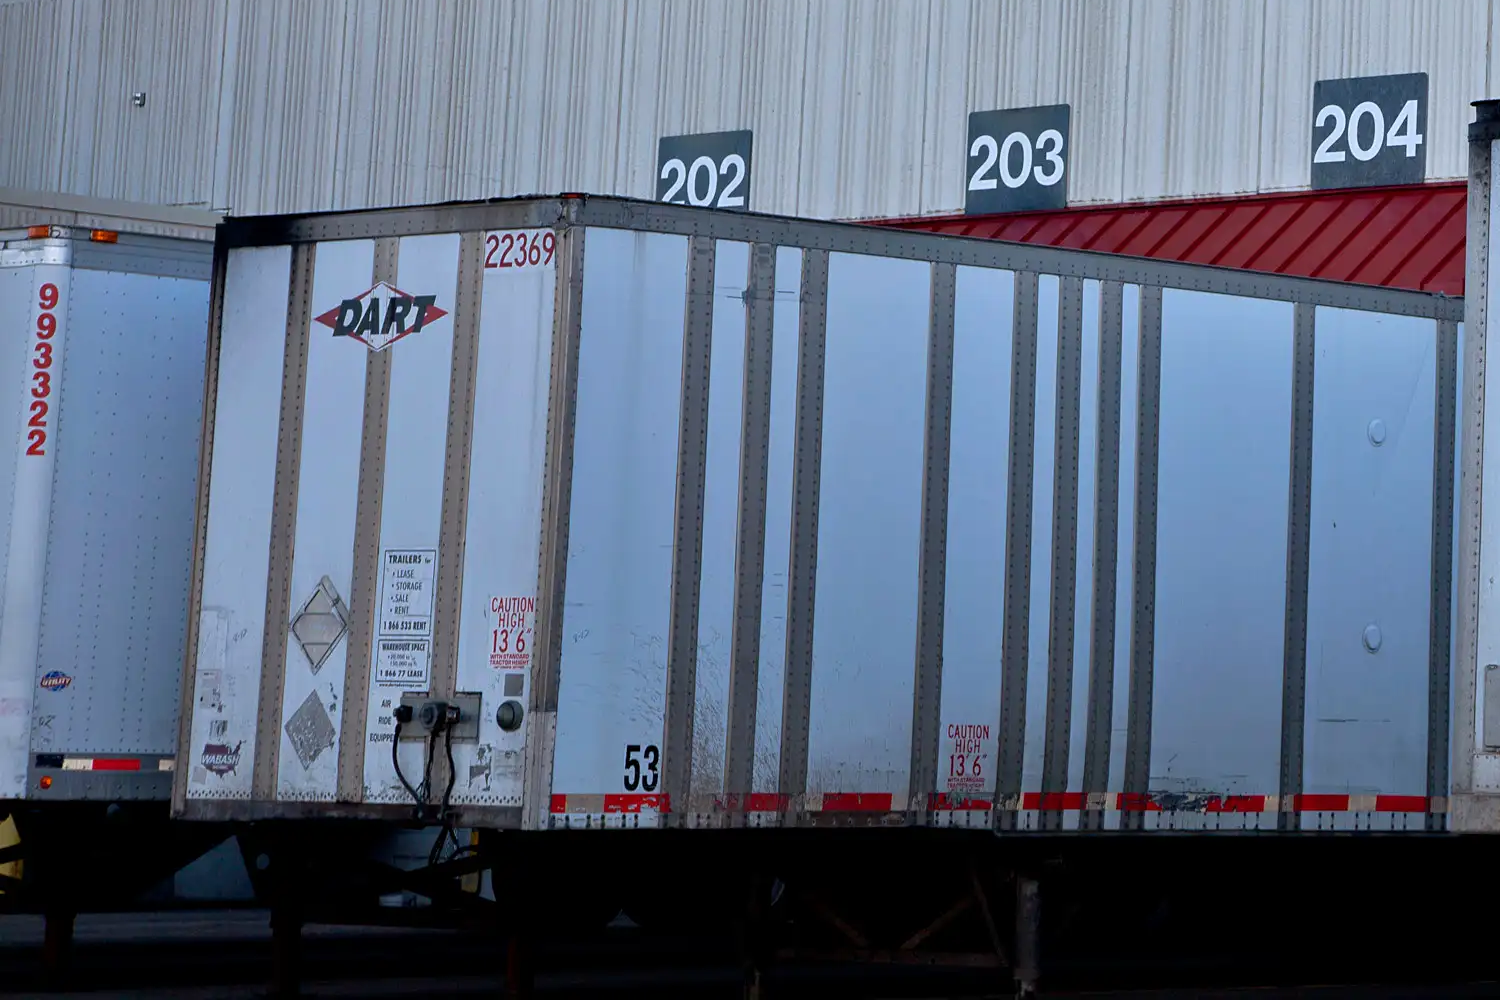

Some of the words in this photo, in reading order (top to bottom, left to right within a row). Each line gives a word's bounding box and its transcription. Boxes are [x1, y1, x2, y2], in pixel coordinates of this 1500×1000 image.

[1313, 100, 1423, 163] 204
[968, 129, 1065, 191] 203
[660, 154, 746, 208] 202
[485, 232, 556, 268] 22369
[333, 295, 437, 337] DART
[26, 283, 59, 456] 993322
[389, 555, 422, 564] TRAILERS
[397, 570, 414, 578] LEASE
[396, 582, 422, 590] STORAGE
[395, 594, 408, 602] SALE
[394, 606, 409, 614] RENT
[492, 597, 534, 612] CAUTION
[388, 621, 399, 630] 866
[400, 622, 411, 630] 533
[413, 622, 426, 630] RENT
[499, 613, 524, 628] HIGH
[382, 643, 410, 651] WAREHOUSE
[381, 700, 391, 708] AIR
[378, 717, 391, 725] RIDE
[948, 724, 989, 739] CAUTION
[370, 733, 395, 743] EQUIPPE
[956, 740, 980, 753] HIGH
[202, 755, 240, 765] WABASH
[624, 745, 659, 792] 53
